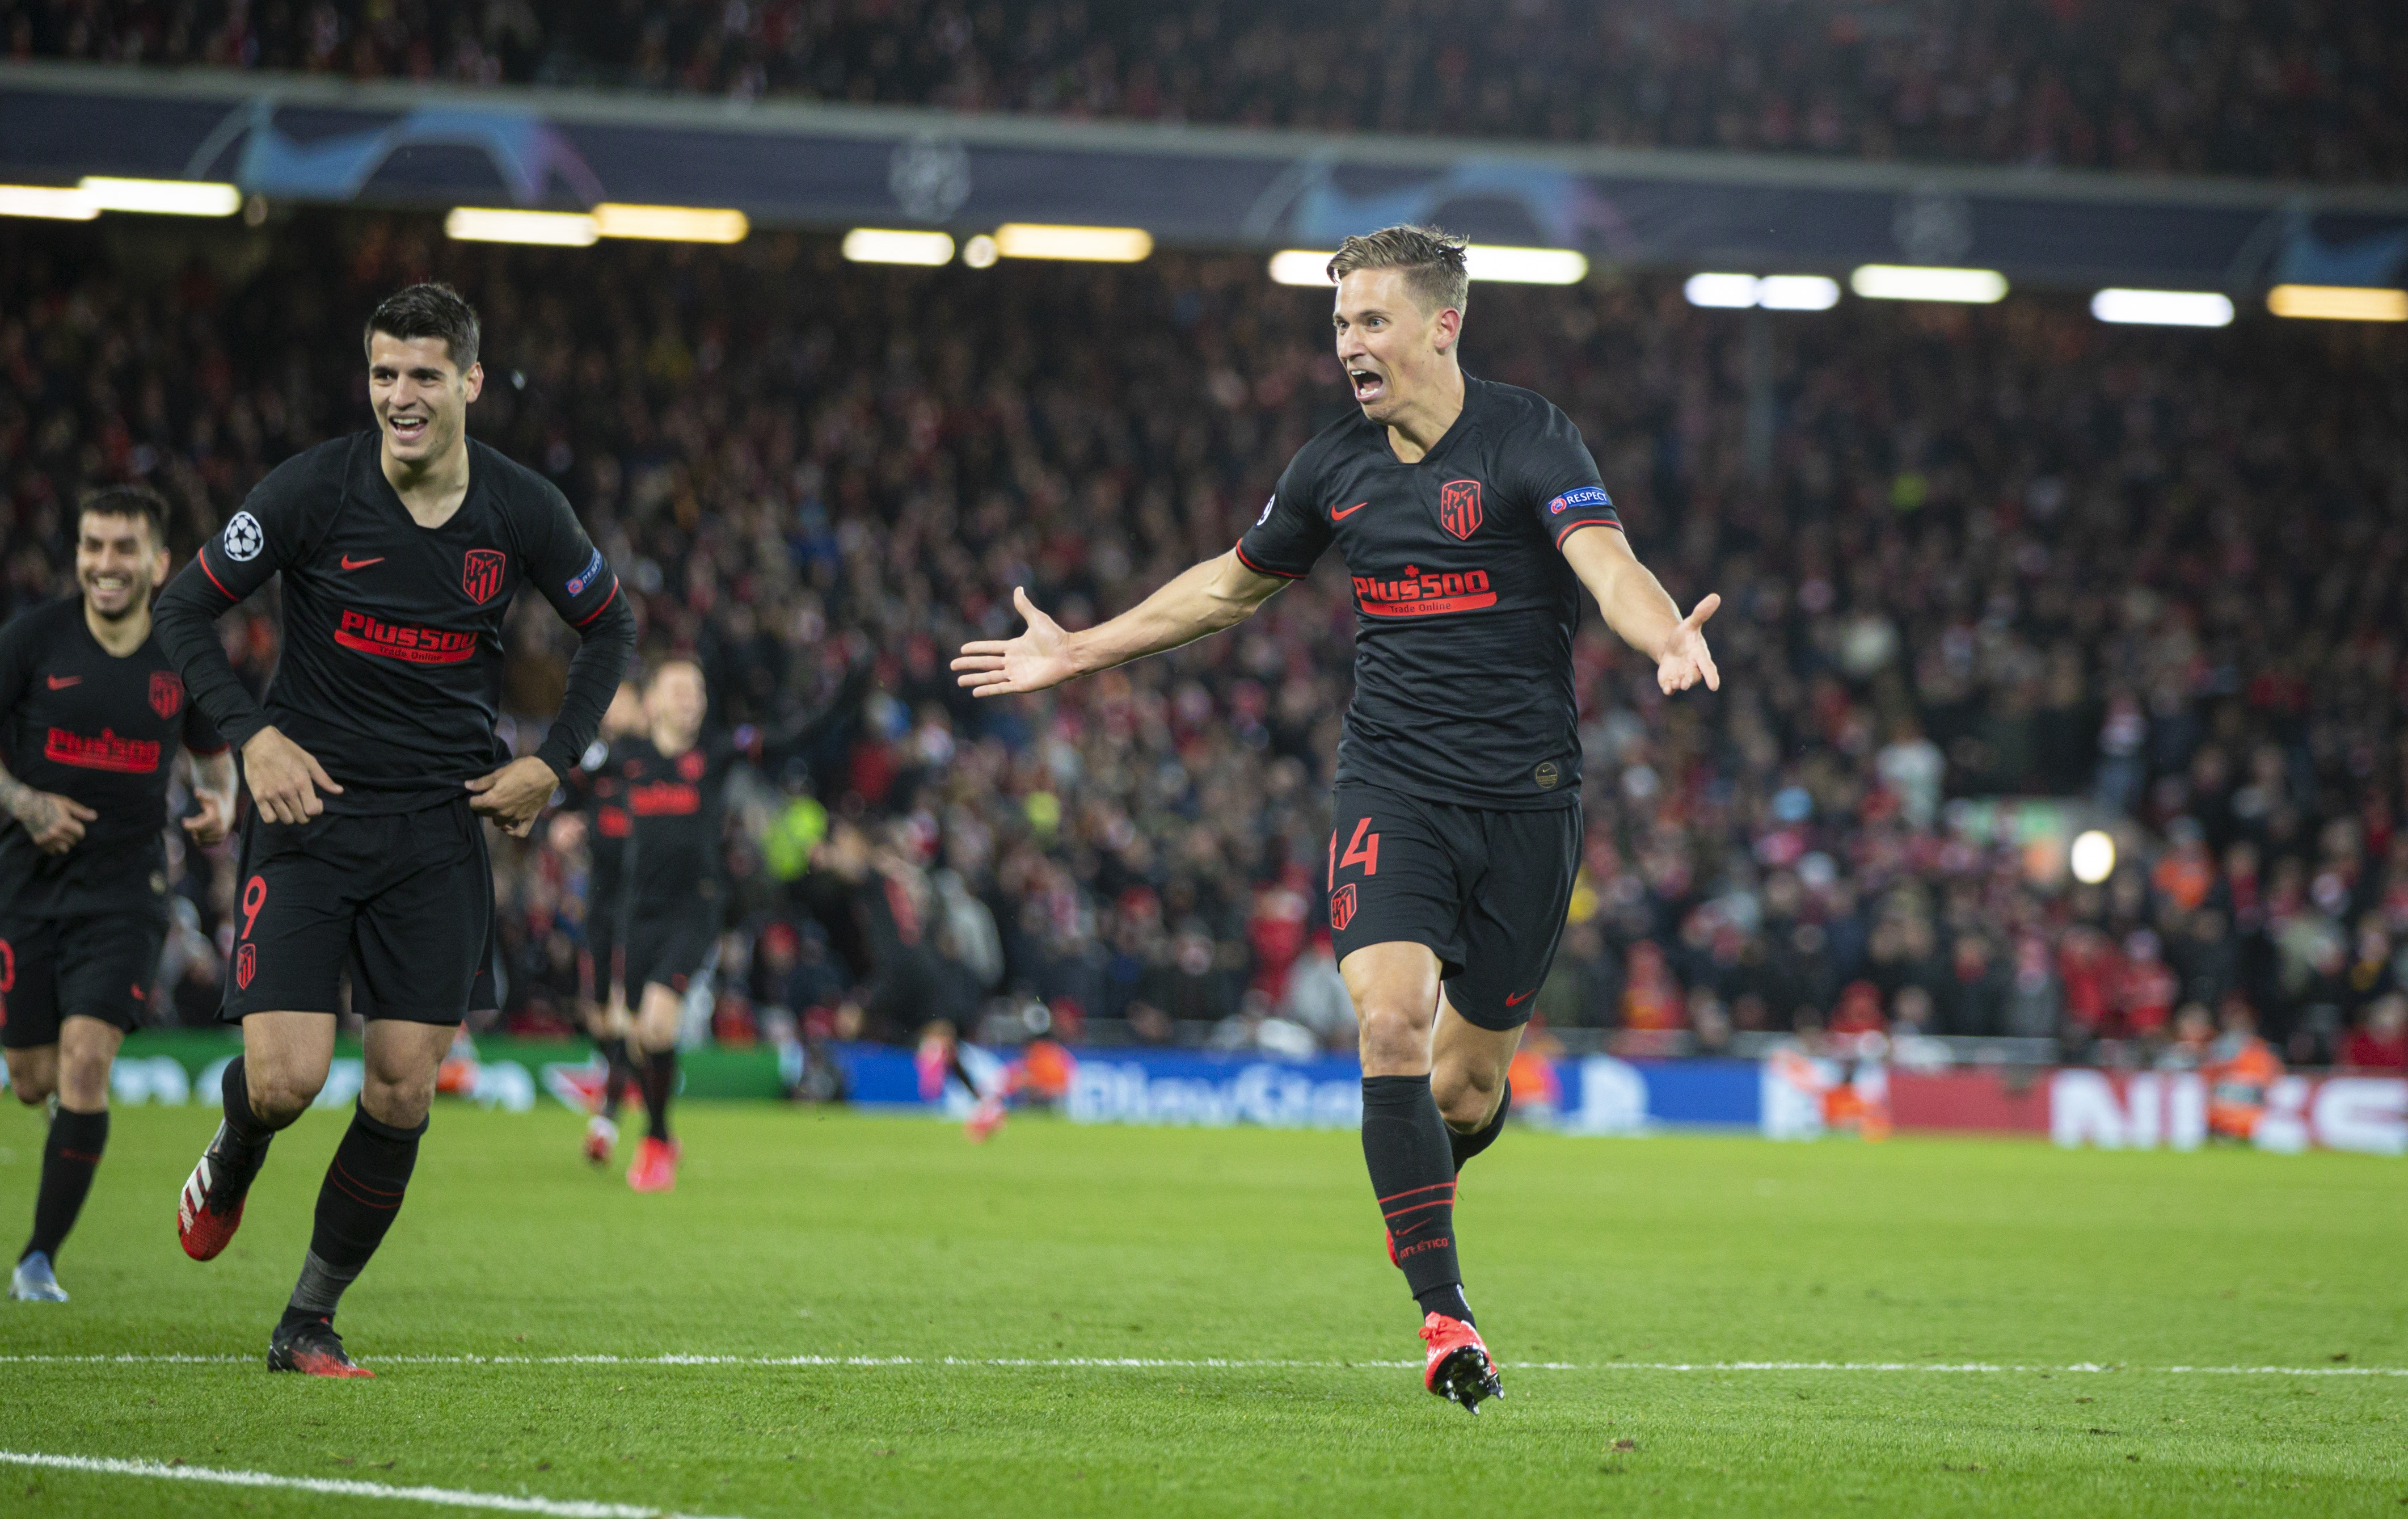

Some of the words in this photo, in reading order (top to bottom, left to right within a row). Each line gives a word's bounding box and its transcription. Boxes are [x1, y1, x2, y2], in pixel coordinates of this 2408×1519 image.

[1566, 491, 1607, 504] RESPECT
[1351, 570, 1490, 601] Plus500
[1419, 603, 1451, 612] Online
[379, 645, 407, 657] Trade
[411, 651, 442, 660] Online
[241, 875, 267, 940] 9
